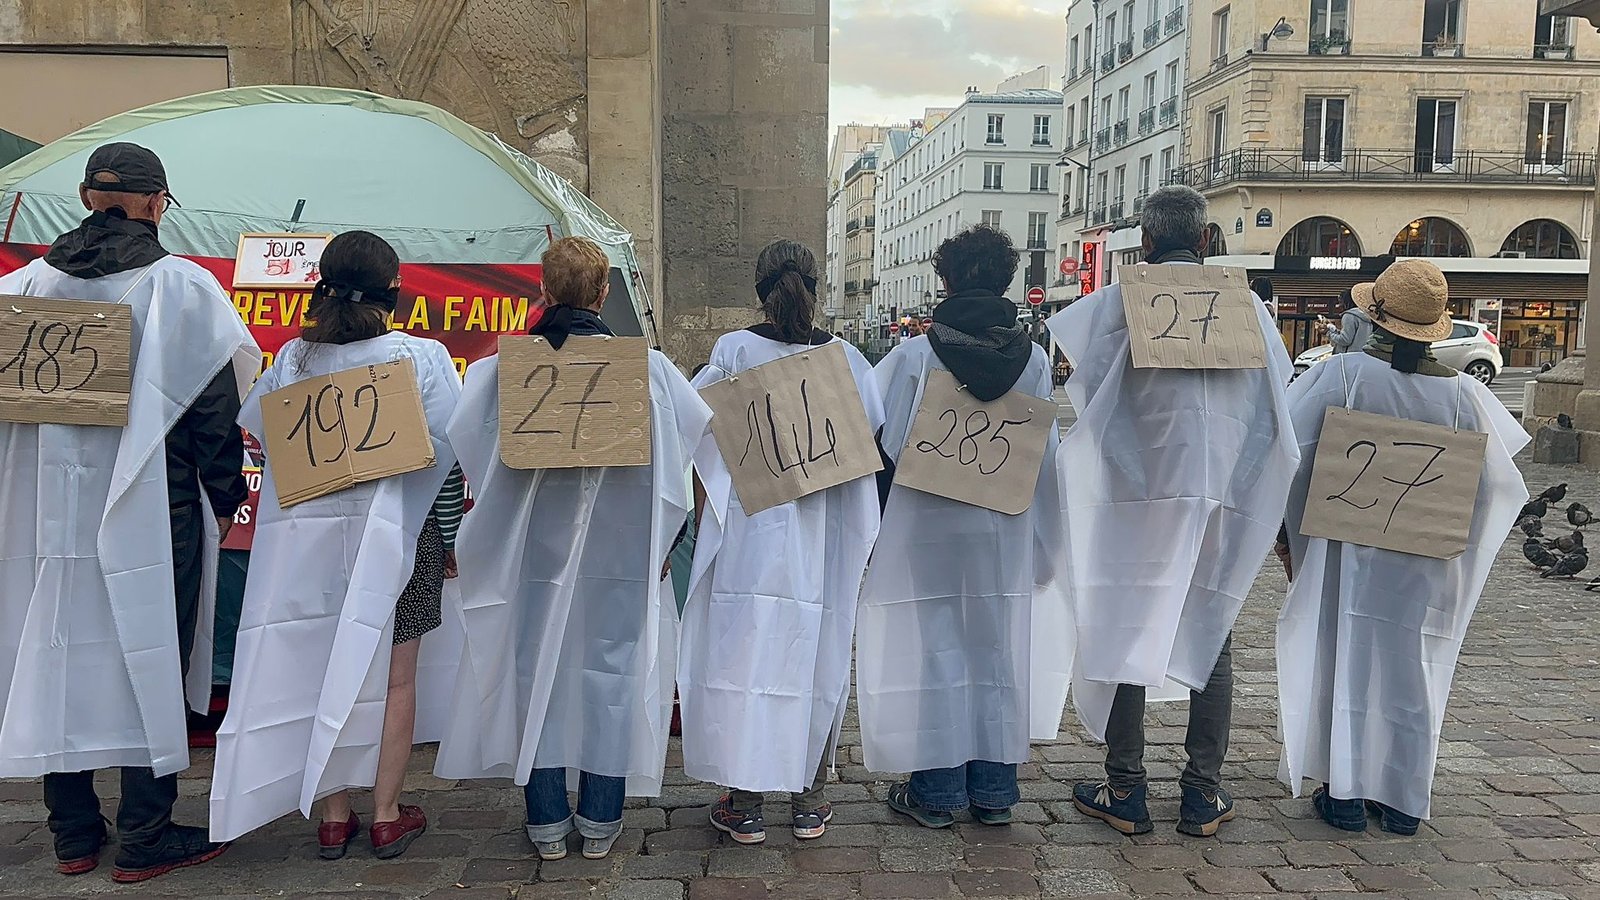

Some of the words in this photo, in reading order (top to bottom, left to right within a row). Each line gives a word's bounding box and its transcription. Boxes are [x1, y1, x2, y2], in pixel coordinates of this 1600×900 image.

[225, 289, 318, 328] REVE
[443, 296, 528, 332] FAIM
[1150, 291, 1220, 344] 27
[0, 320, 108, 394] 185
[286, 383, 396, 468] 192
[512, 361, 613, 450] 27
[739, 379, 840, 479] 144
[916, 409, 1031, 475] 285
[1326, 440, 1446, 534] 27
